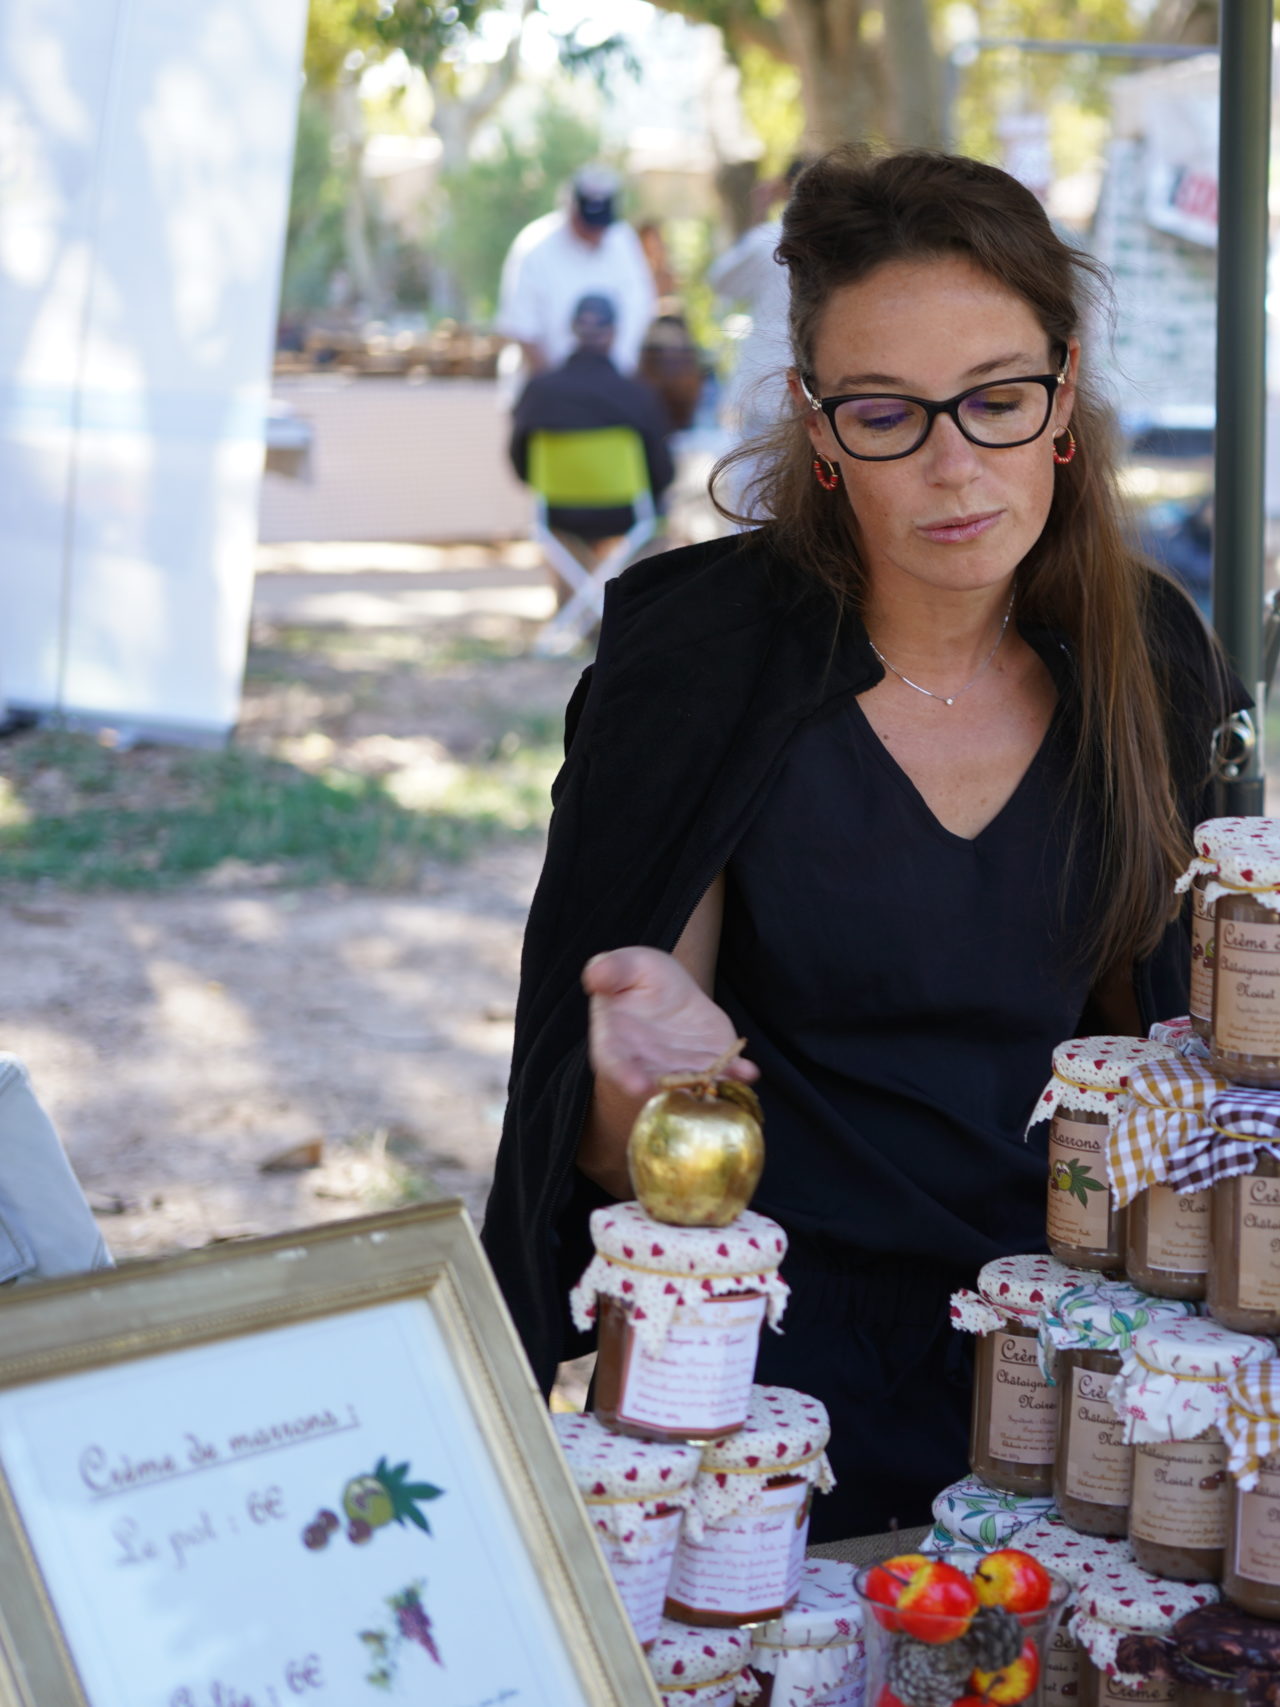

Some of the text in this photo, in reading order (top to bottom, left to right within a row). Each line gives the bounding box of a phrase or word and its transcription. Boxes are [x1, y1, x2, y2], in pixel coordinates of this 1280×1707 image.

[1223, 923, 1267, 949] Crème
[78, 1444, 177, 1493] Crème
[184, 1432, 218, 1465] de
[227, 1408, 338, 1451] marrons
[246, 1484, 287, 1526] 6€
[284, 1652, 325, 1696] 6€
